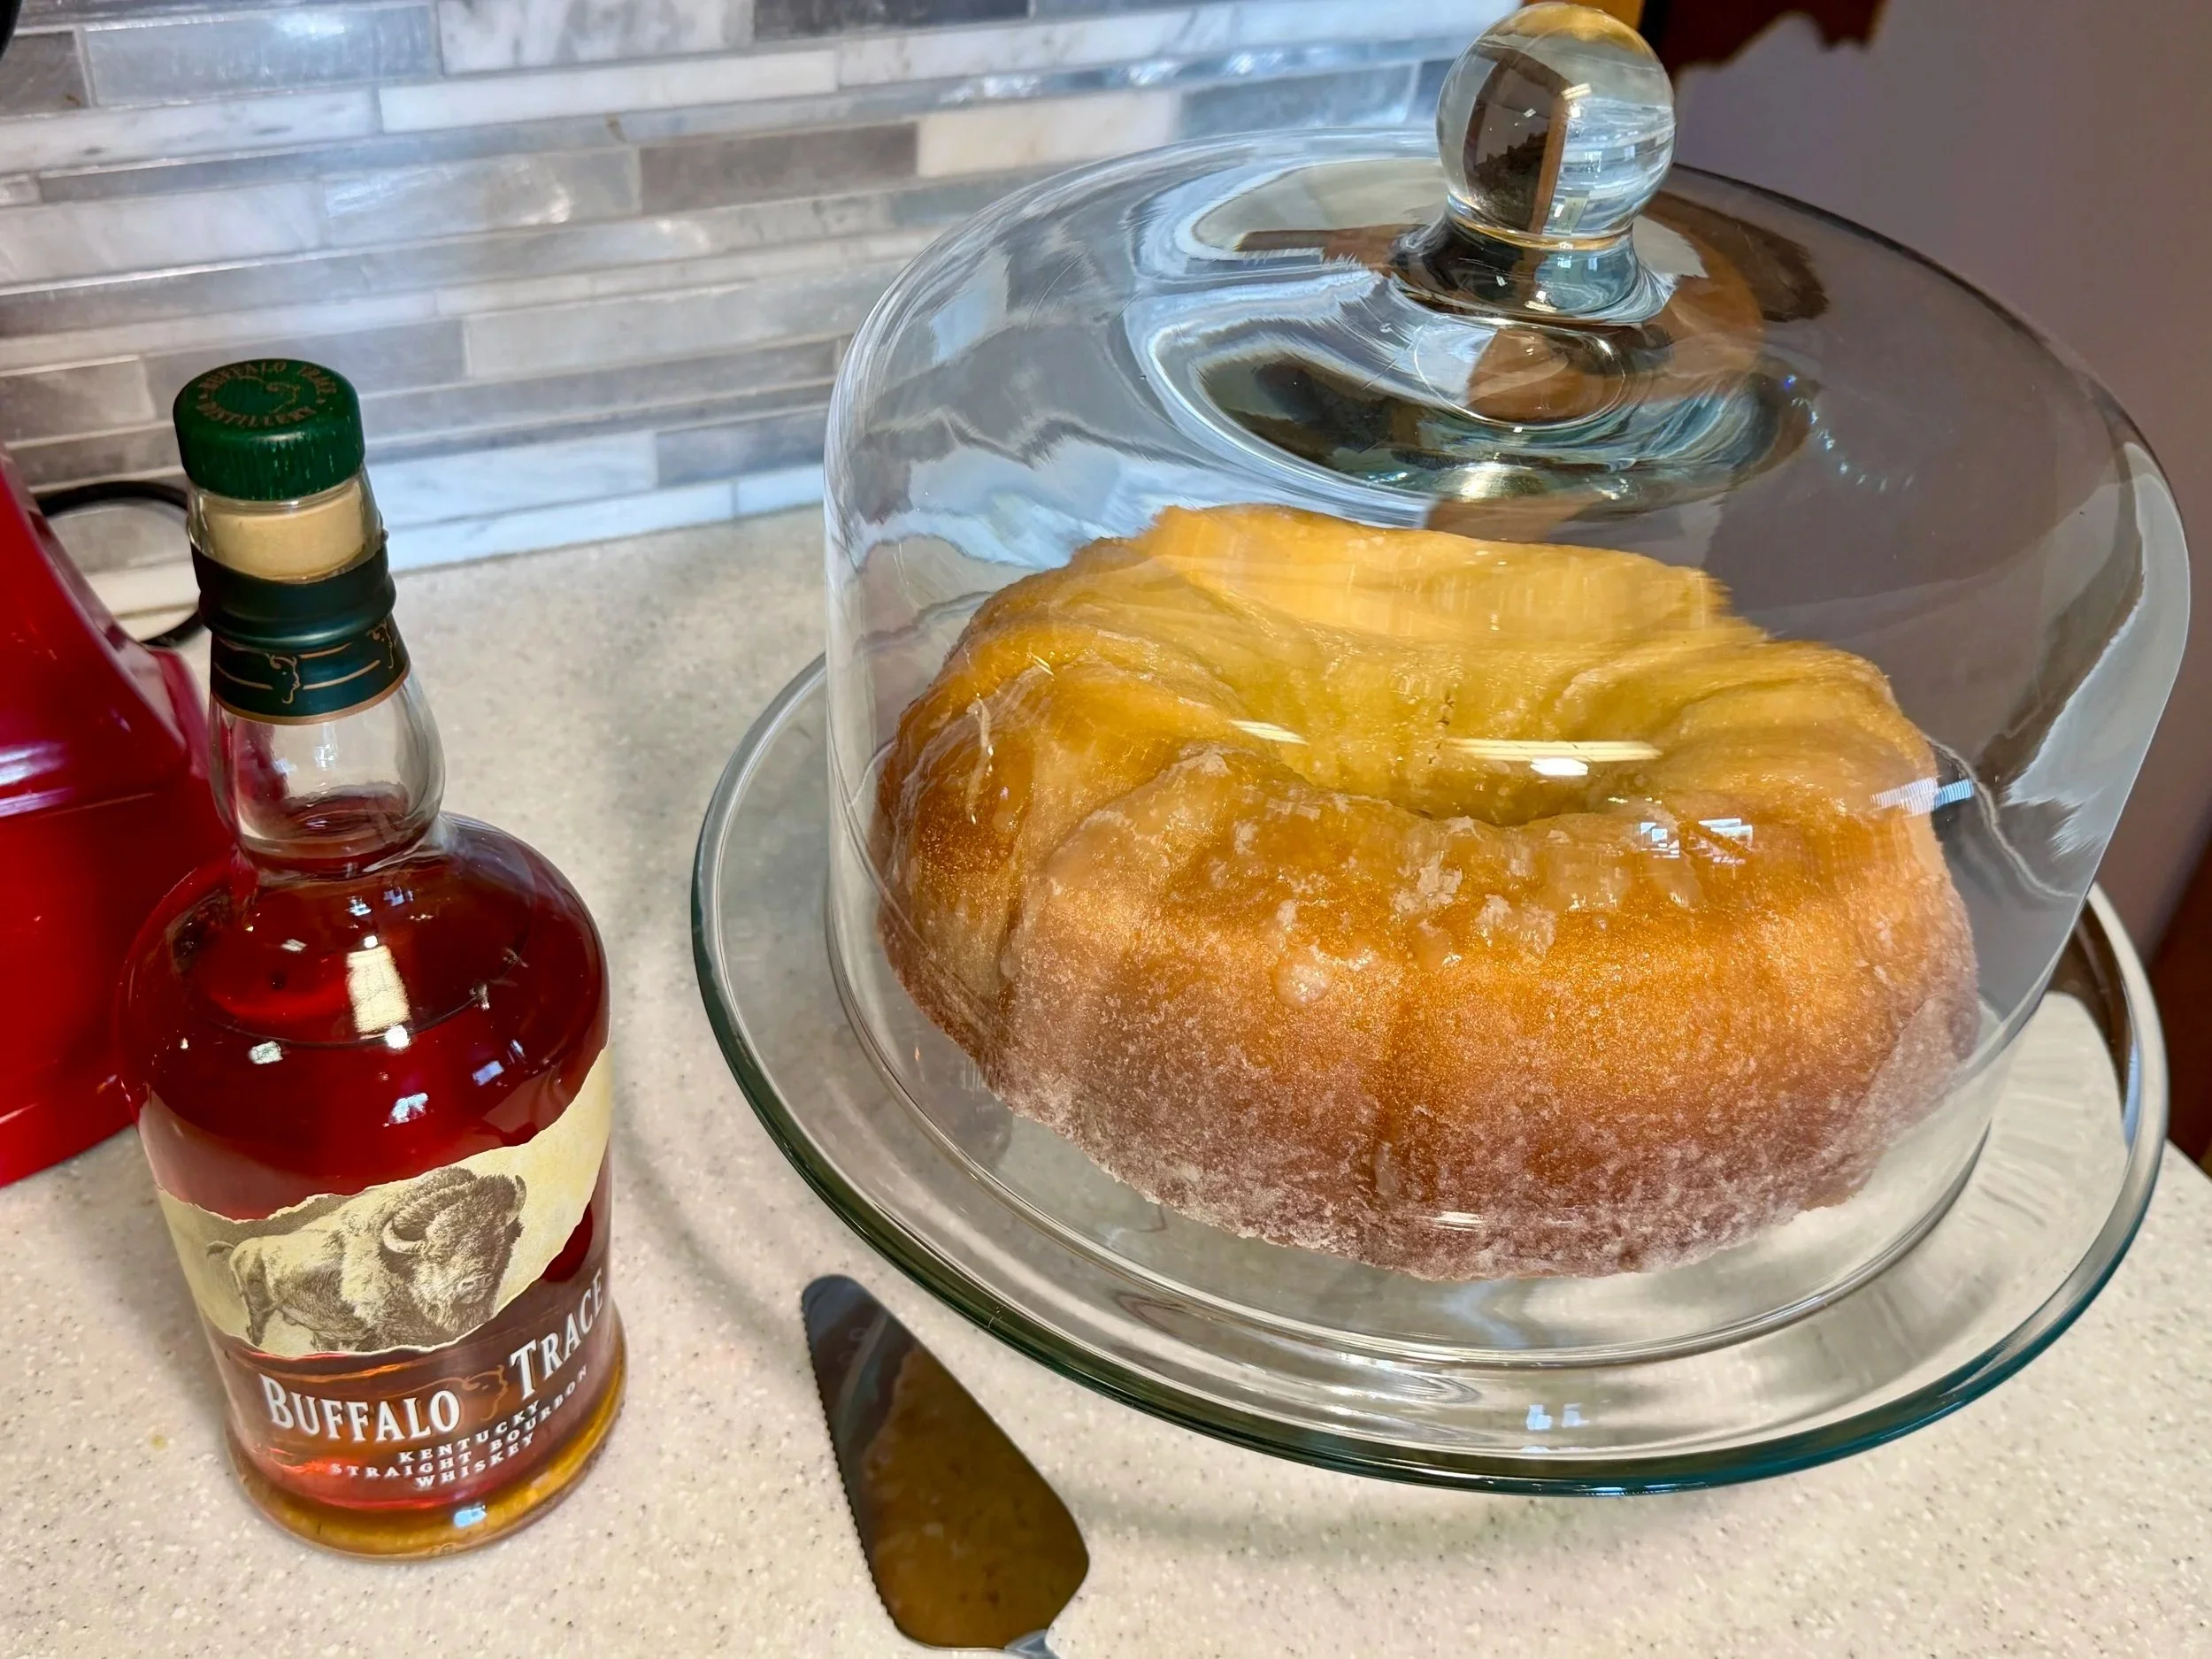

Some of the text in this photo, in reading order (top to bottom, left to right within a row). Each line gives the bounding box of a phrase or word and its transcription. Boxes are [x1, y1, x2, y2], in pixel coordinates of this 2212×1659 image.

[259, 1269, 603, 1442] BUFFALO TRACE
[330, 1363, 588, 1478] STRAIGHT BOURBON
[398, 1400, 540, 1463] KENTUCKY
[414, 1432, 534, 1488] WHISKEY
